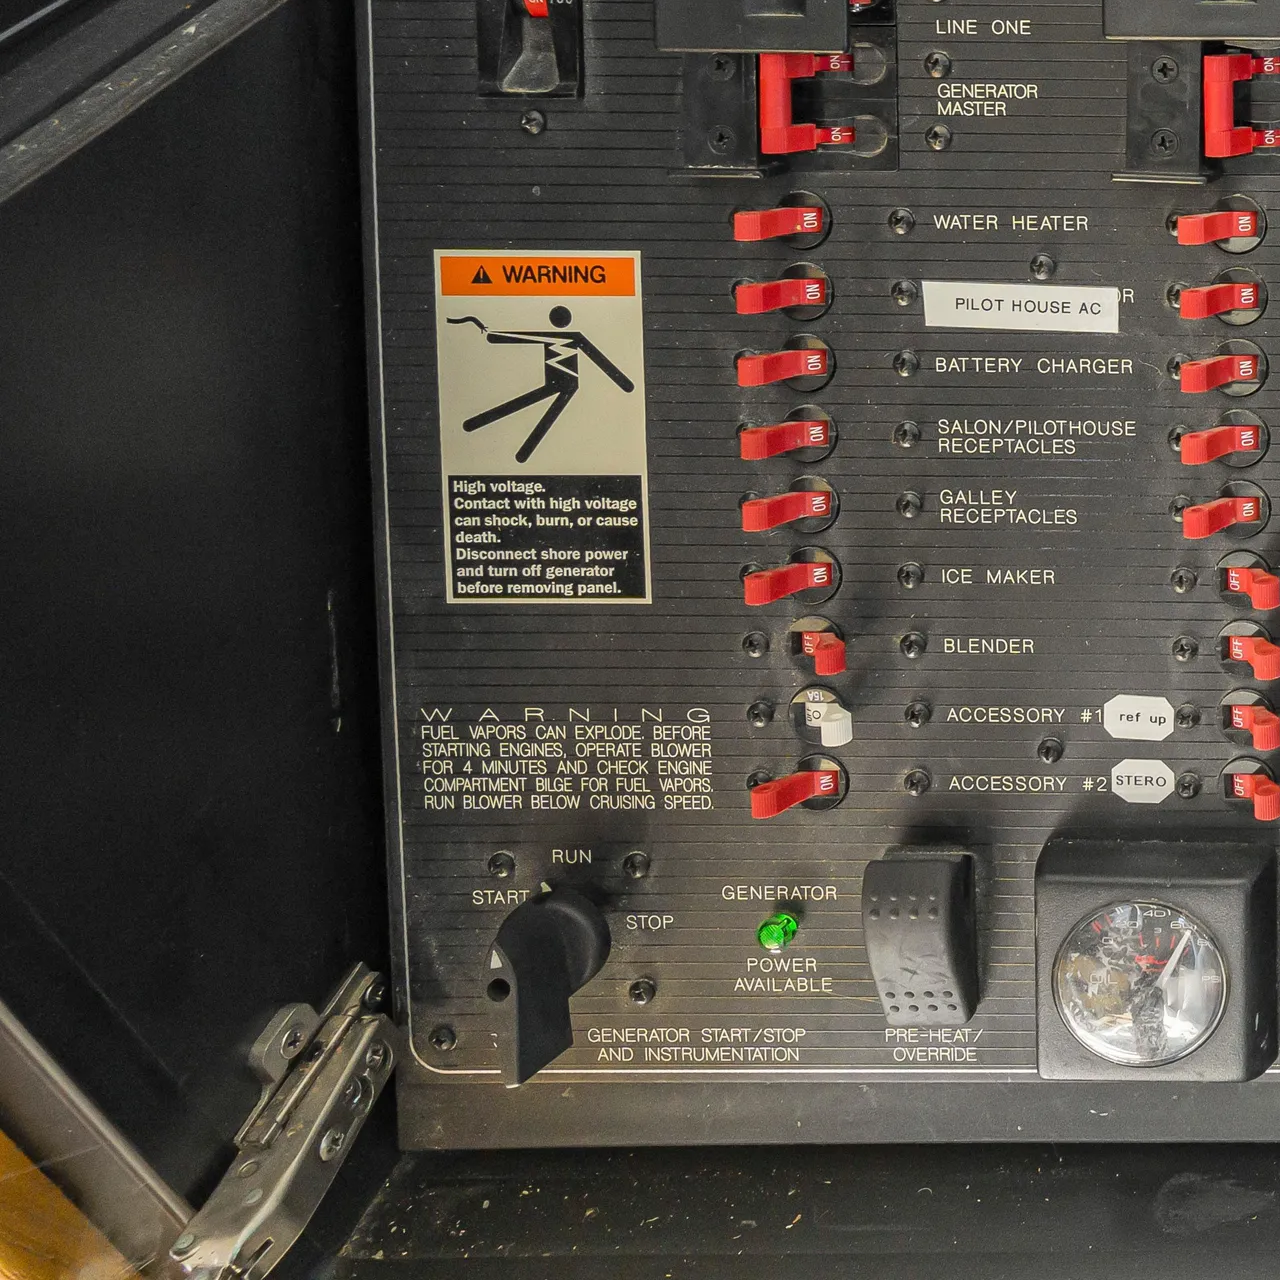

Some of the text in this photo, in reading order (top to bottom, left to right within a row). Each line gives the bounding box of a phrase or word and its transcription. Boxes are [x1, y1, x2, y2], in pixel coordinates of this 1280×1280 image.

[933, 214, 1089, 231] WATER HEATER
[502, 264, 606, 284] WARNING
[955, 297, 1101, 316] PILOT HOUSE AC
[938, 418, 1137, 436] SALON/PILOTHOUSE
[938, 437, 1076, 455] RECEPTACLES
[453, 480, 546, 496] High voltage.
[453, 496, 638, 513] Contact with high voltage
[454, 513, 639, 529] can shock, burn, or cause
[1119, 712, 1167, 727] ref up
[421, 724, 712, 741] FUEL VAPORS CAN EXPLODE. BEFORE
[948, 775, 1107, 792] ACCESSORY #2
[1115, 774, 1167, 788] STERO
[424, 794, 714, 810] RUN BLOWER BELOW CRUISING SPEED.
[626, 914, 674, 930] STOP
[747, 957, 817, 973] POWER
[733, 977, 833, 994] AVAILABLE
[884, 1028, 984, 1044] PRE-HEAT/
[890, 1046, 978, 1062] OVERRIDE
